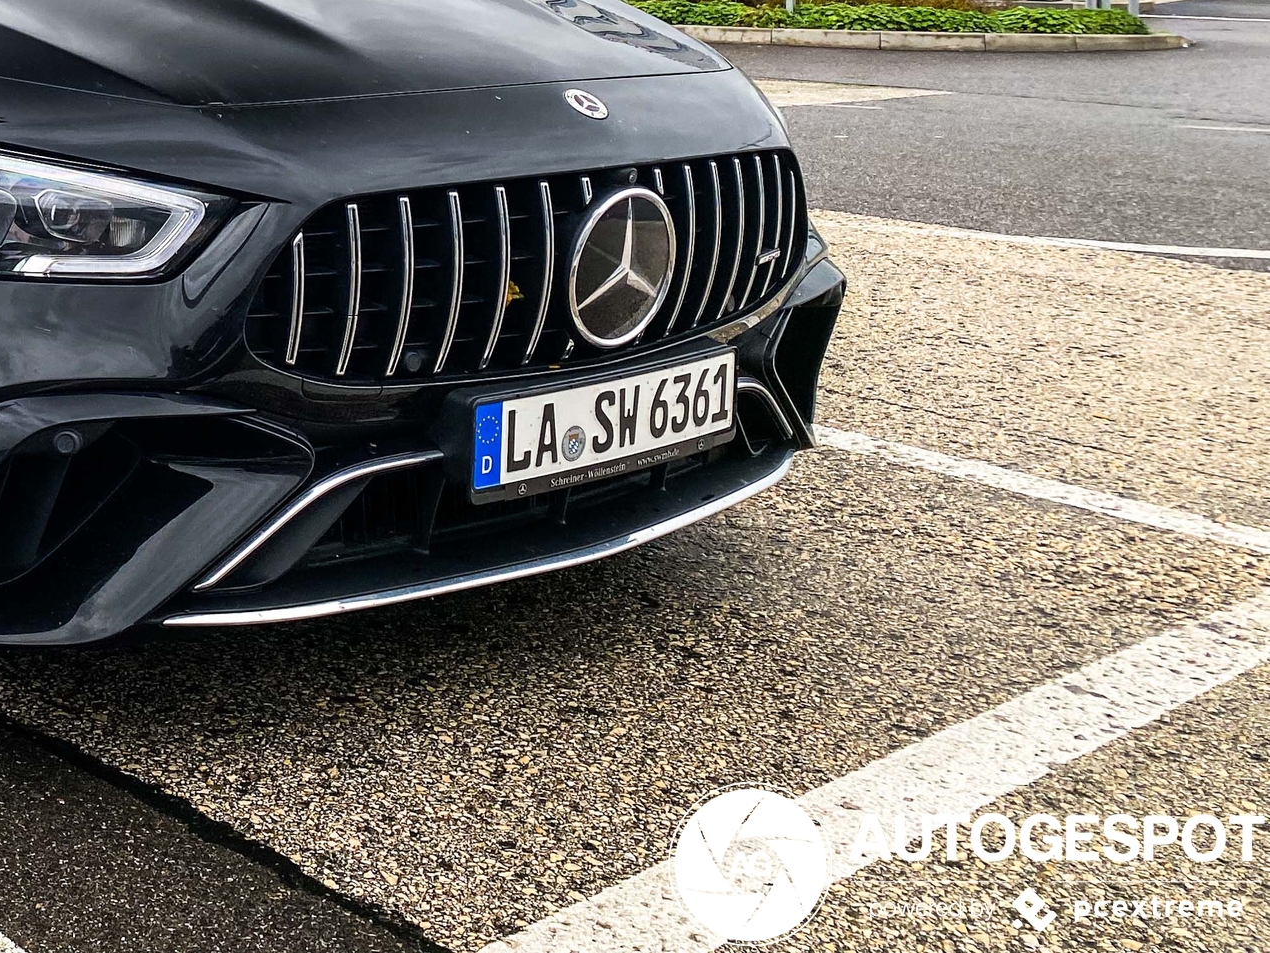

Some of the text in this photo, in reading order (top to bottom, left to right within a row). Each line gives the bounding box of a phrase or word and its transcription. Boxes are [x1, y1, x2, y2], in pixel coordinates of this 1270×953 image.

[505, 362, 729, 474] LA SW 6361
[480, 454, 493, 476] D
